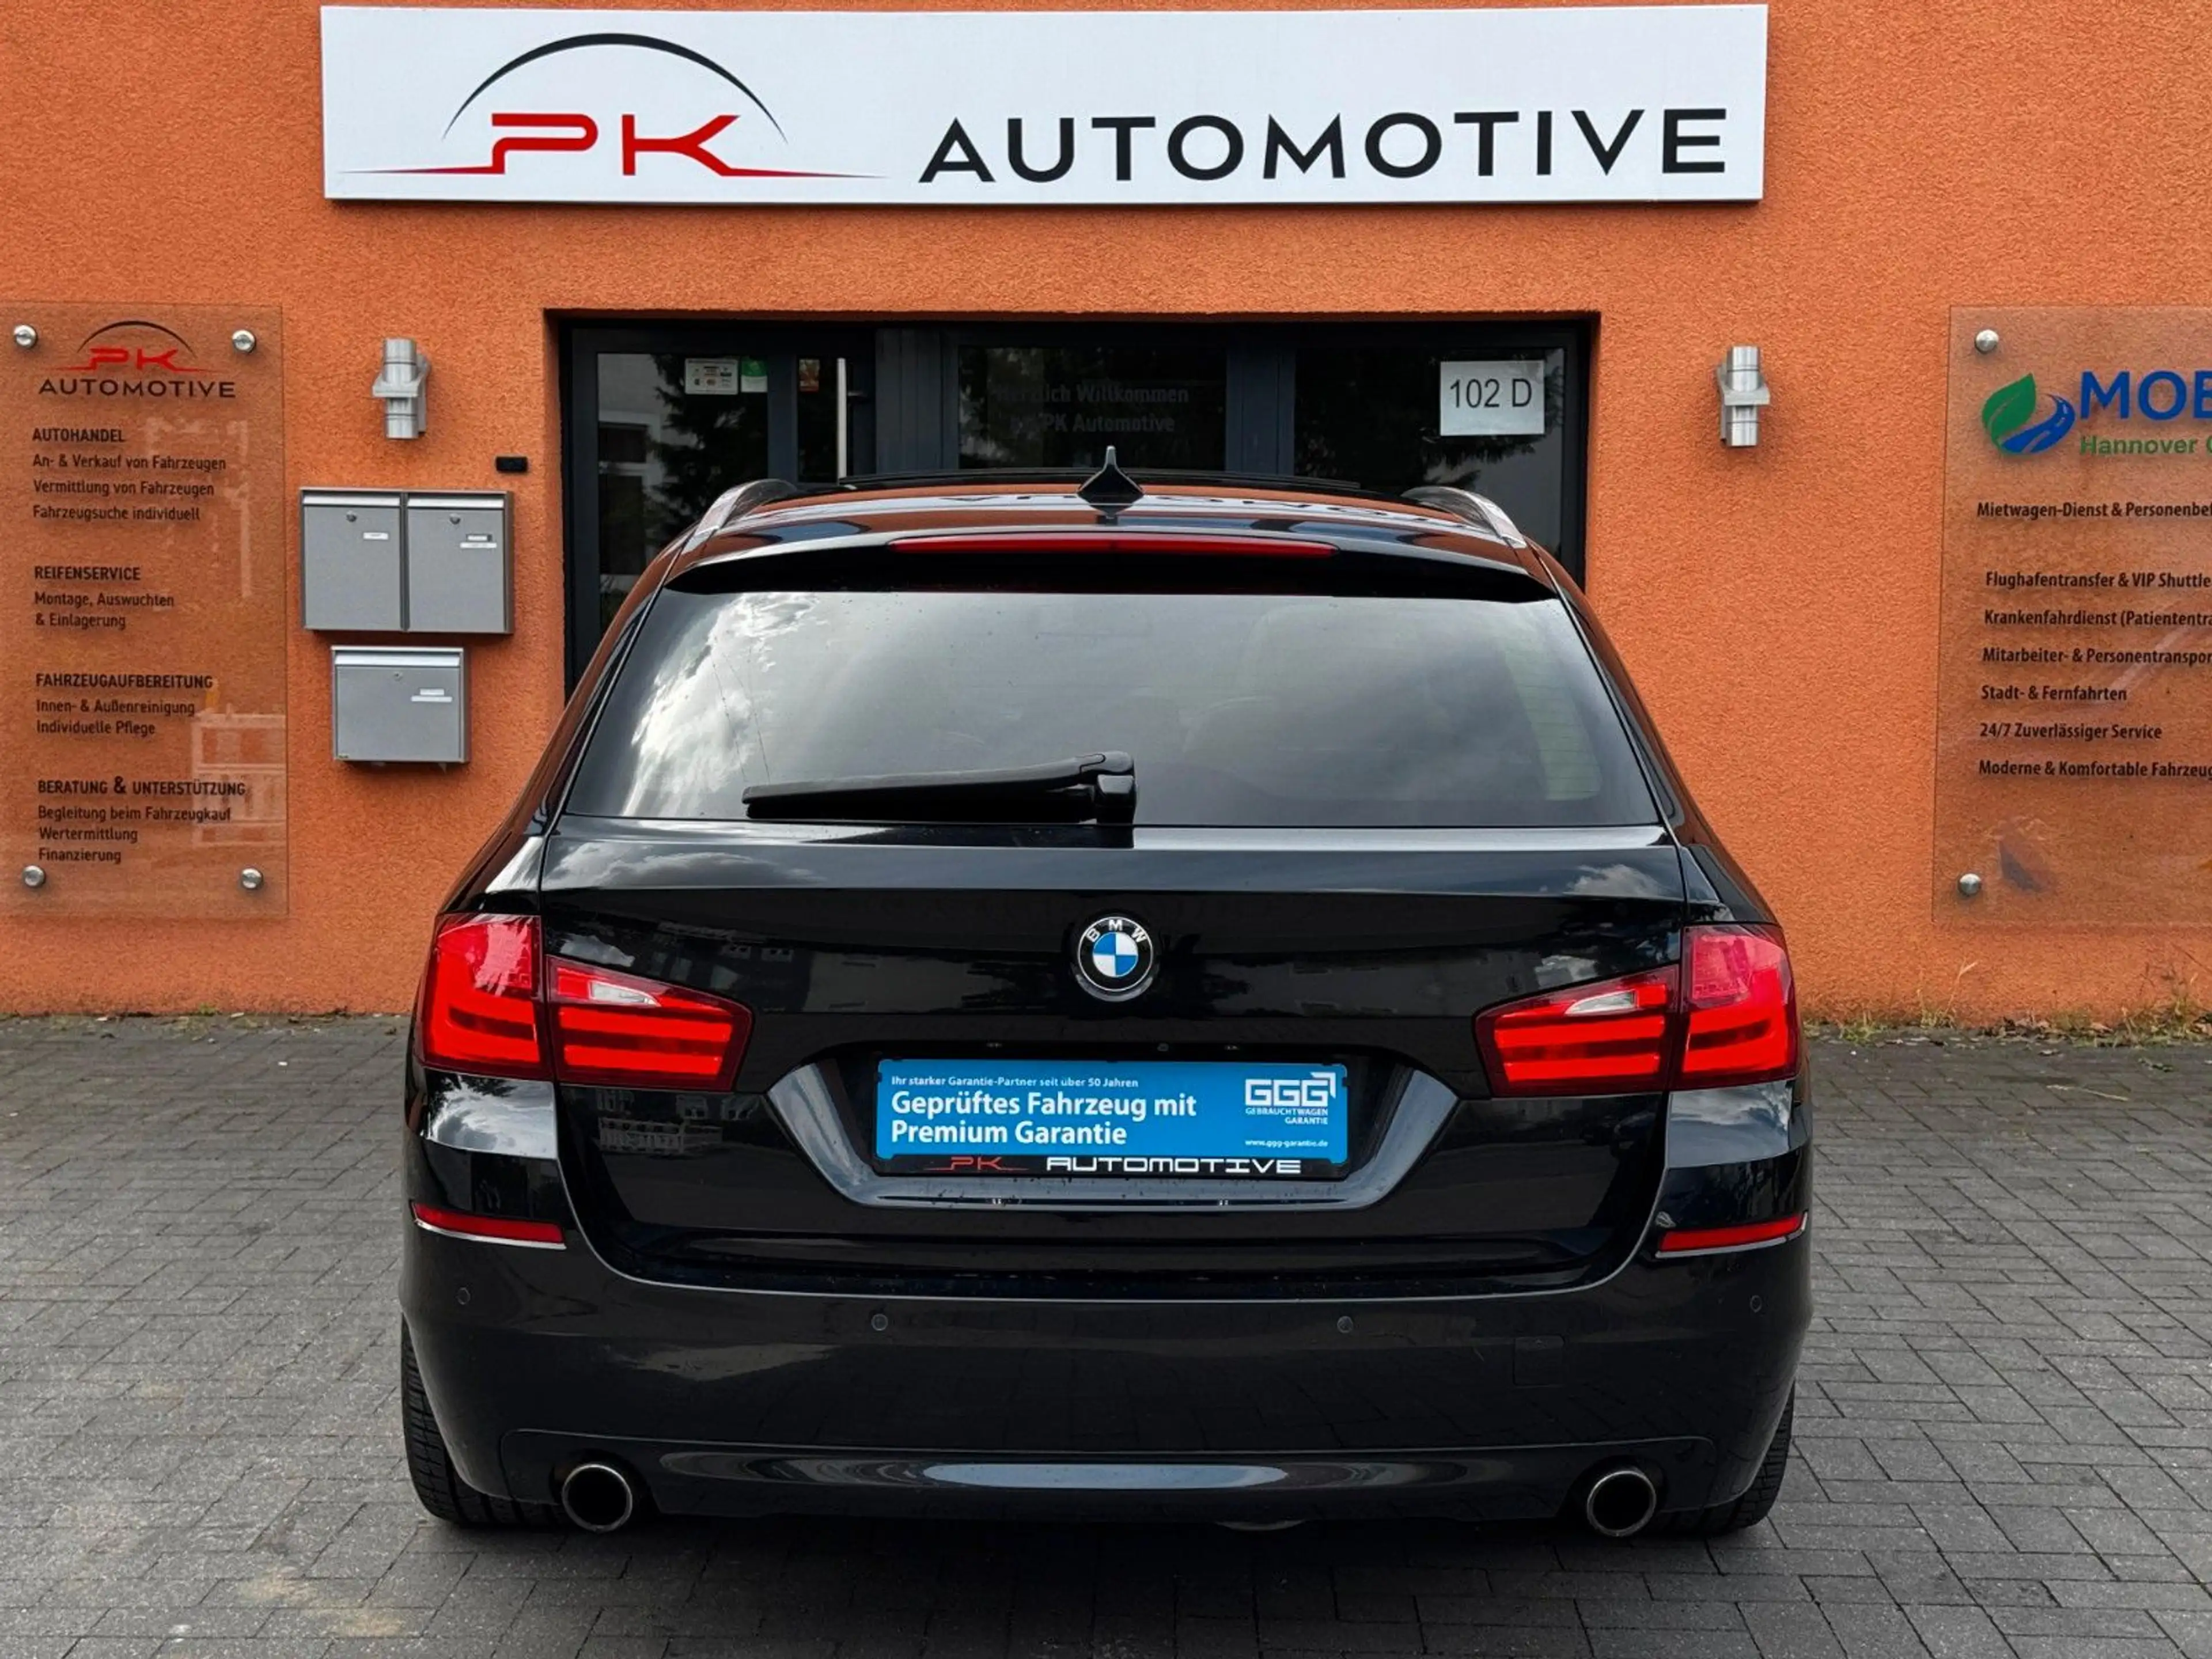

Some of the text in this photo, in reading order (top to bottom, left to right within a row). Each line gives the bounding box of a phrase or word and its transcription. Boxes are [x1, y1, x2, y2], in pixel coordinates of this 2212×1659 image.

[491, 113, 740, 177] PK
[918, 108, 1726, 183] AUTOMOTIVE
[89, 347, 179, 372] PK
[38, 378, 236, 398] AUTOMOTIVE
[995, 381, 1189, 404] Hlich Willkommen
[1449, 379, 1532, 408] 102 D
[1073, 411, 1176, 433] Automotive
[32, 428, 126, 442] AUTOHANDEL
[2080, 436, 2198, 454] Hannover
[32, 453, 226, 471] An- & Verkauf von Fahrzeugen
[33, 480, 214, 497] Vermittlung von Fahrzeugen
[33, 505, 200, 522] Fahrzeugsuche individuell
[1977, 503, 2108, 520] Mietwagen-Dienst
[2112, 503, 2122, 516] &
[35, 566, 141, 581] REIFENSERVICE
[1986, 572, 2211, 589] Flughafentransfer & VIP Shuttle
[35, 592, 174, 607] Montage, Auswuchten
[35, 613, 126, 629] & Einlagerung
[1985, 611, 2116, 625] Krankenfahrdienst
[1983, 649, 2068, 662] Mitarbeiter-
[2073, 649, 2082, 662] &
[36, 673, 213, 688] FAHRZEUGAUFBEREITUNG
[1982, 686, 2127, 700] Stadt- & Fernfahrten
[37, 699, 195, 716] Innen- & Außenreinigung
[37, 721, 156, 737] Individuelle Pflege
[1980, 724, 2162, 741] 24/7 Zuverlässiger Service
[1980, 760, 2040, 775] Moderne
[2044, 762, 2055, 775] &
[2060, 762, 2147, 777] Komfortable
[38, 776, 246, 796] BERATUNG & UNTERSTÜTZUNG
[38, 806, 232, 822] Begleitung beim Fahrzeugkauf
[39, 828, 138, 843] Wertermittlung
[39, 848, 122, 863] Finanzierung
[1086, 920, 1147, 942] BMW
[892, 1076, 1139, 1088] Ihr starker Garantie-Partner seit über 50 Jahren
[1245, 1079, 1328, 1107] GGG
[892, 1090, 1196, 1122] Geprüftes Fahrzeug mit
[1245, 1107, 1328, 1116] GEBRAUCHTWAGEN
[1285, 1116, 1328, 1124] GARANTIE
[892, 1120, 1127, 1145] Premium Garantie
[1245, 1139, 1328, 1147] www.ggg-garantie.de
[951, 1157, 1301, 1173] PK AUTOMOTIVE
